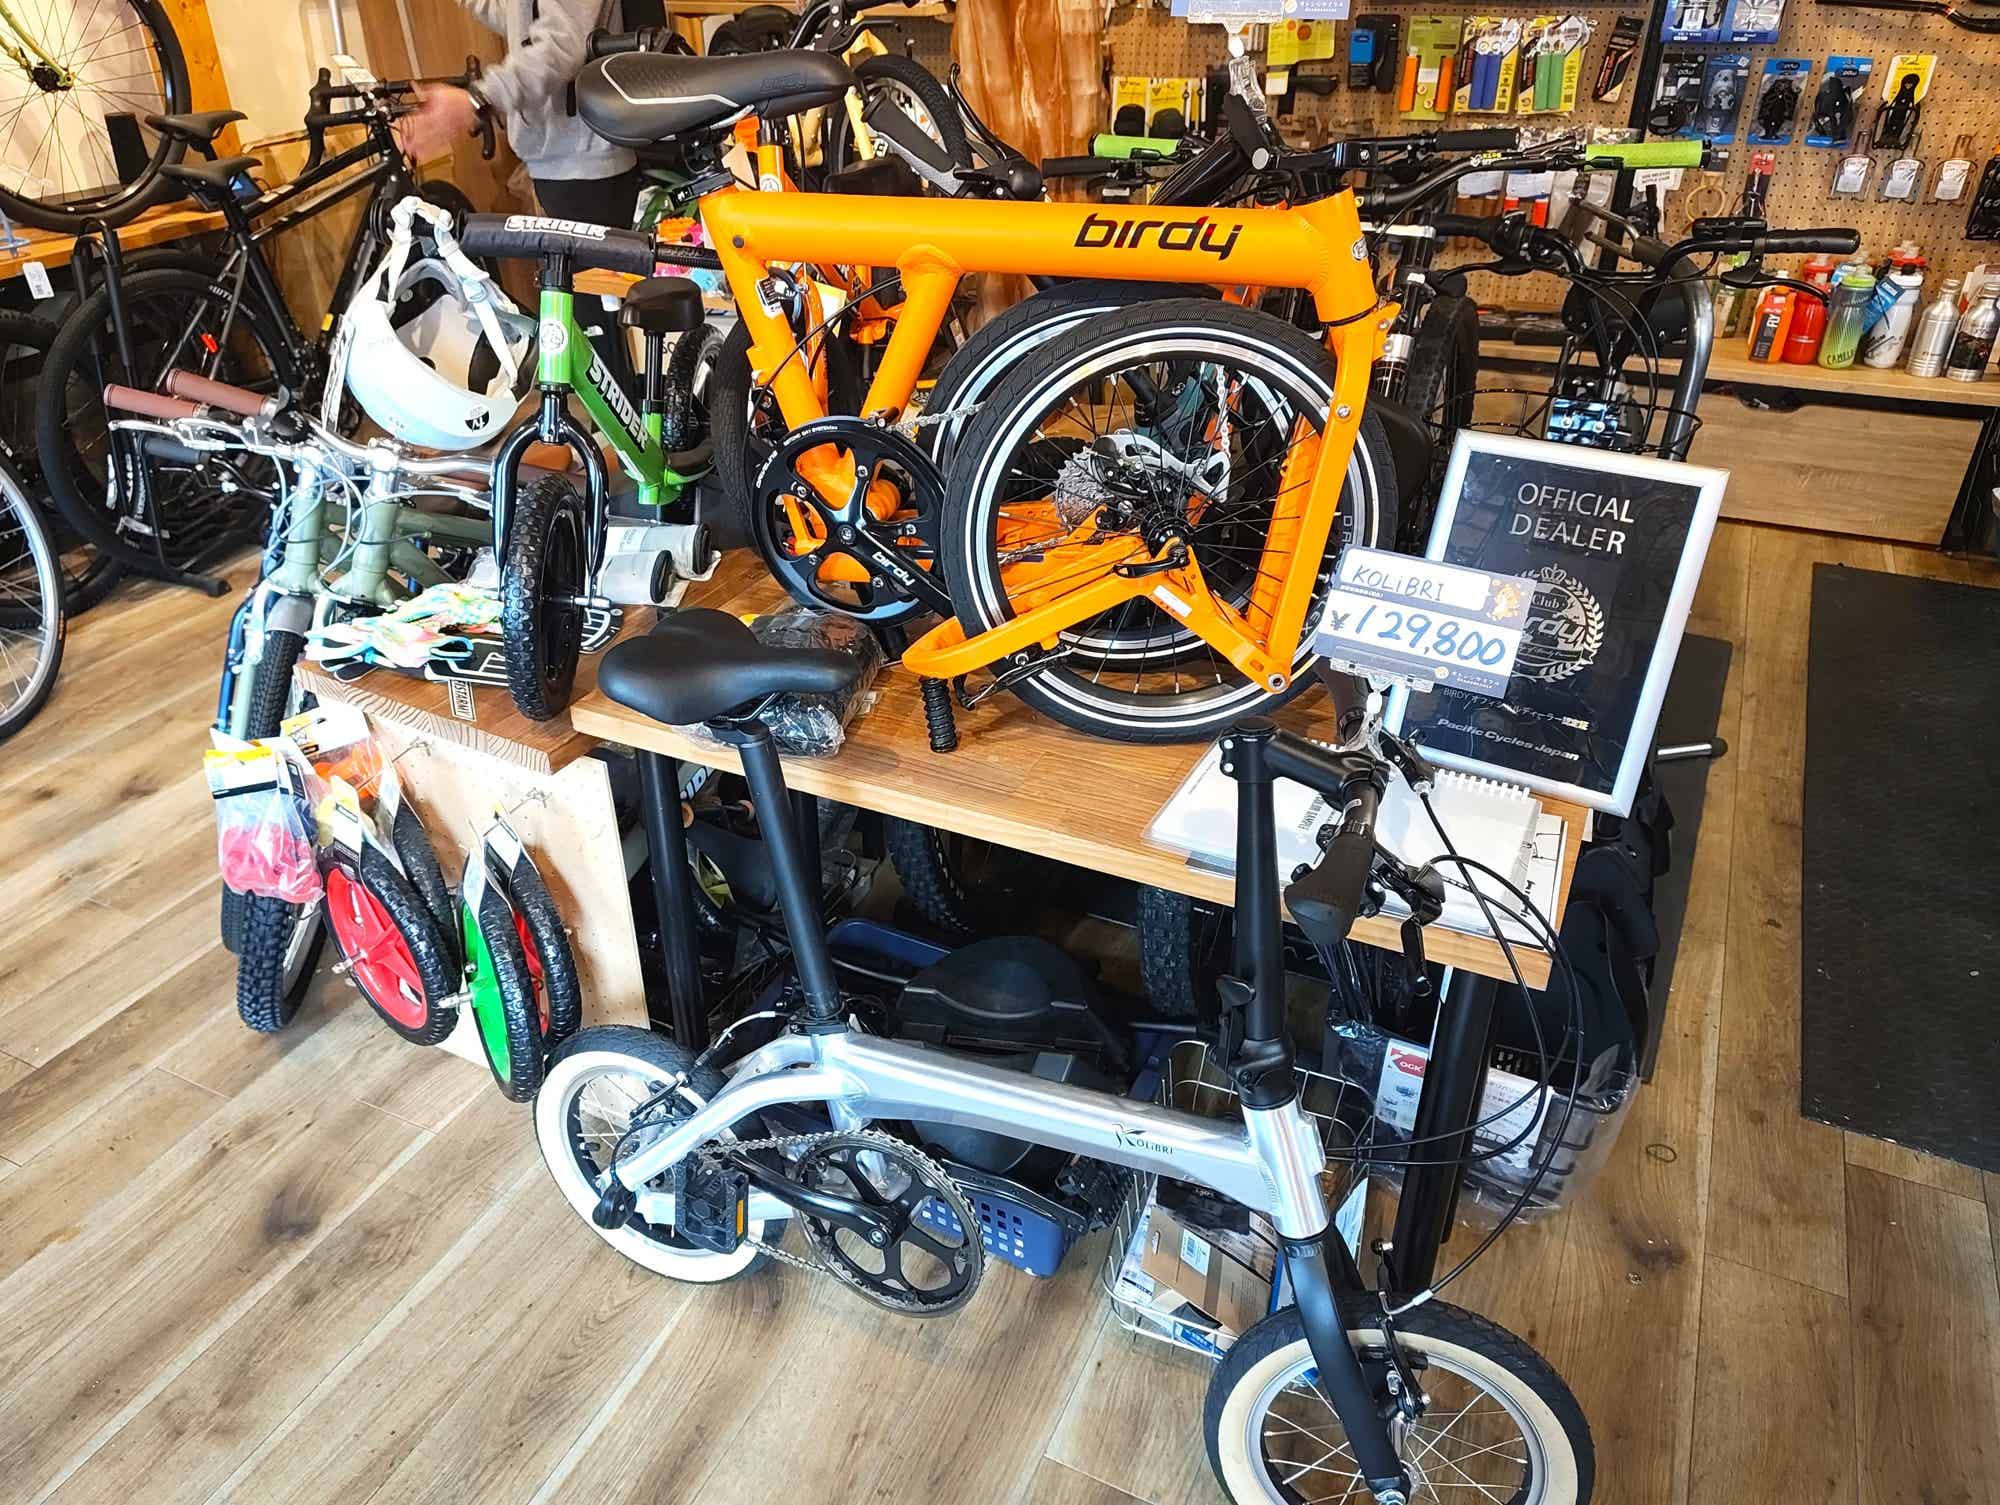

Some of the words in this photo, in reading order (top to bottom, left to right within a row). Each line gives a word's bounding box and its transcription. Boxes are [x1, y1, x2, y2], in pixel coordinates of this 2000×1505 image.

[505, 215, 610, 240] STRIDER
[1074, 213, 1243, 261] birdy
[586, 354, 648, 453] STRIDER
[1518, 483, 1635, 523] OFFICIAL
[1510, 513, 1626, 554] DEALER
[872, 551, 916, 586] birdy
[1532, 594, 1560, 610] Club
[1437, 718, 1484, 737] Pacific
[1484, 730, 1533, 749] Cycles
[1535, 743, 1580, 761] Japan
[1399, 1060, 1426, 1073] OGK
